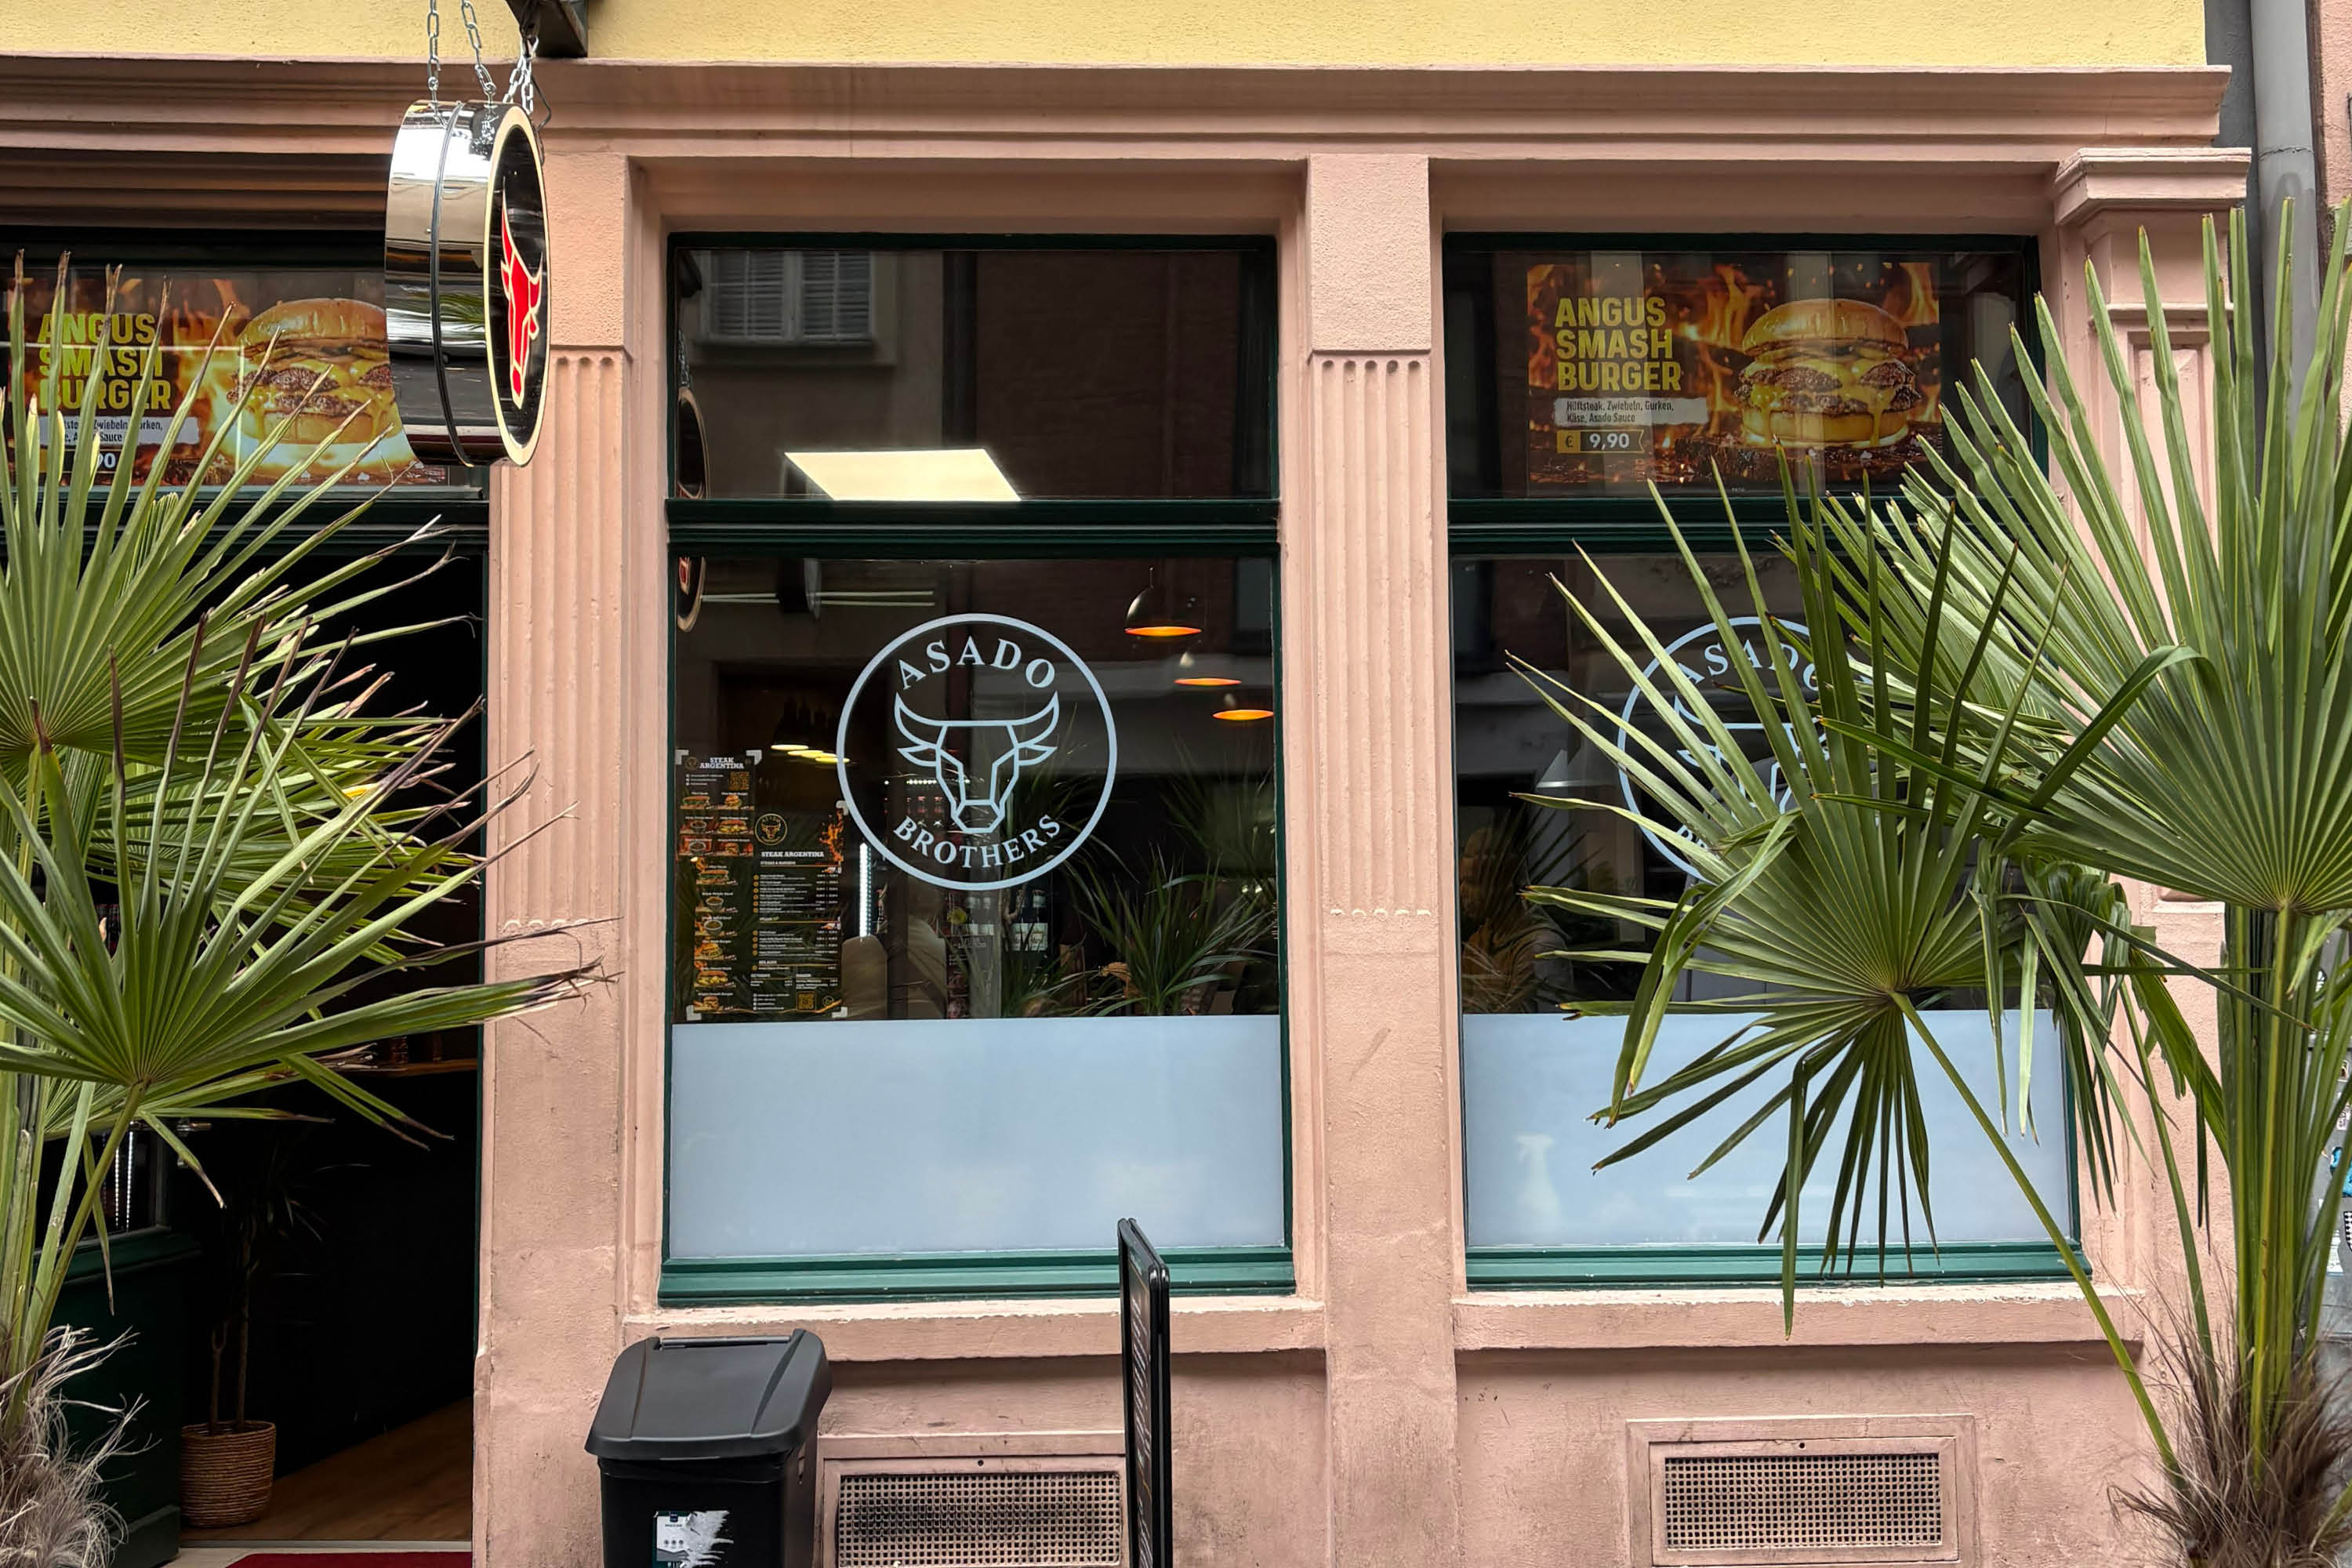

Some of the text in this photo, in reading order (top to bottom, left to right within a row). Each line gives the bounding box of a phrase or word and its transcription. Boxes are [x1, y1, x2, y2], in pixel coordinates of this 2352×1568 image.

[1555, 296, 1666, 328] ANGUS
[1555, 328, 1673, 359] SMASH
[1557, 361, 1682, 391] BURGER
[1567, 413, 1588, 423] Käse,
[1613, 413, 1635, 423] Sauce
[1607, 401, 1643, 412] Zwiebeln,
[1645, 401, 1675, 412] Gurken,
[1589, 433, 1630, 451] 9,90
[898, 635, 1056, 691] ASADO
[892, 813, 1061, 869] BROTHERS
